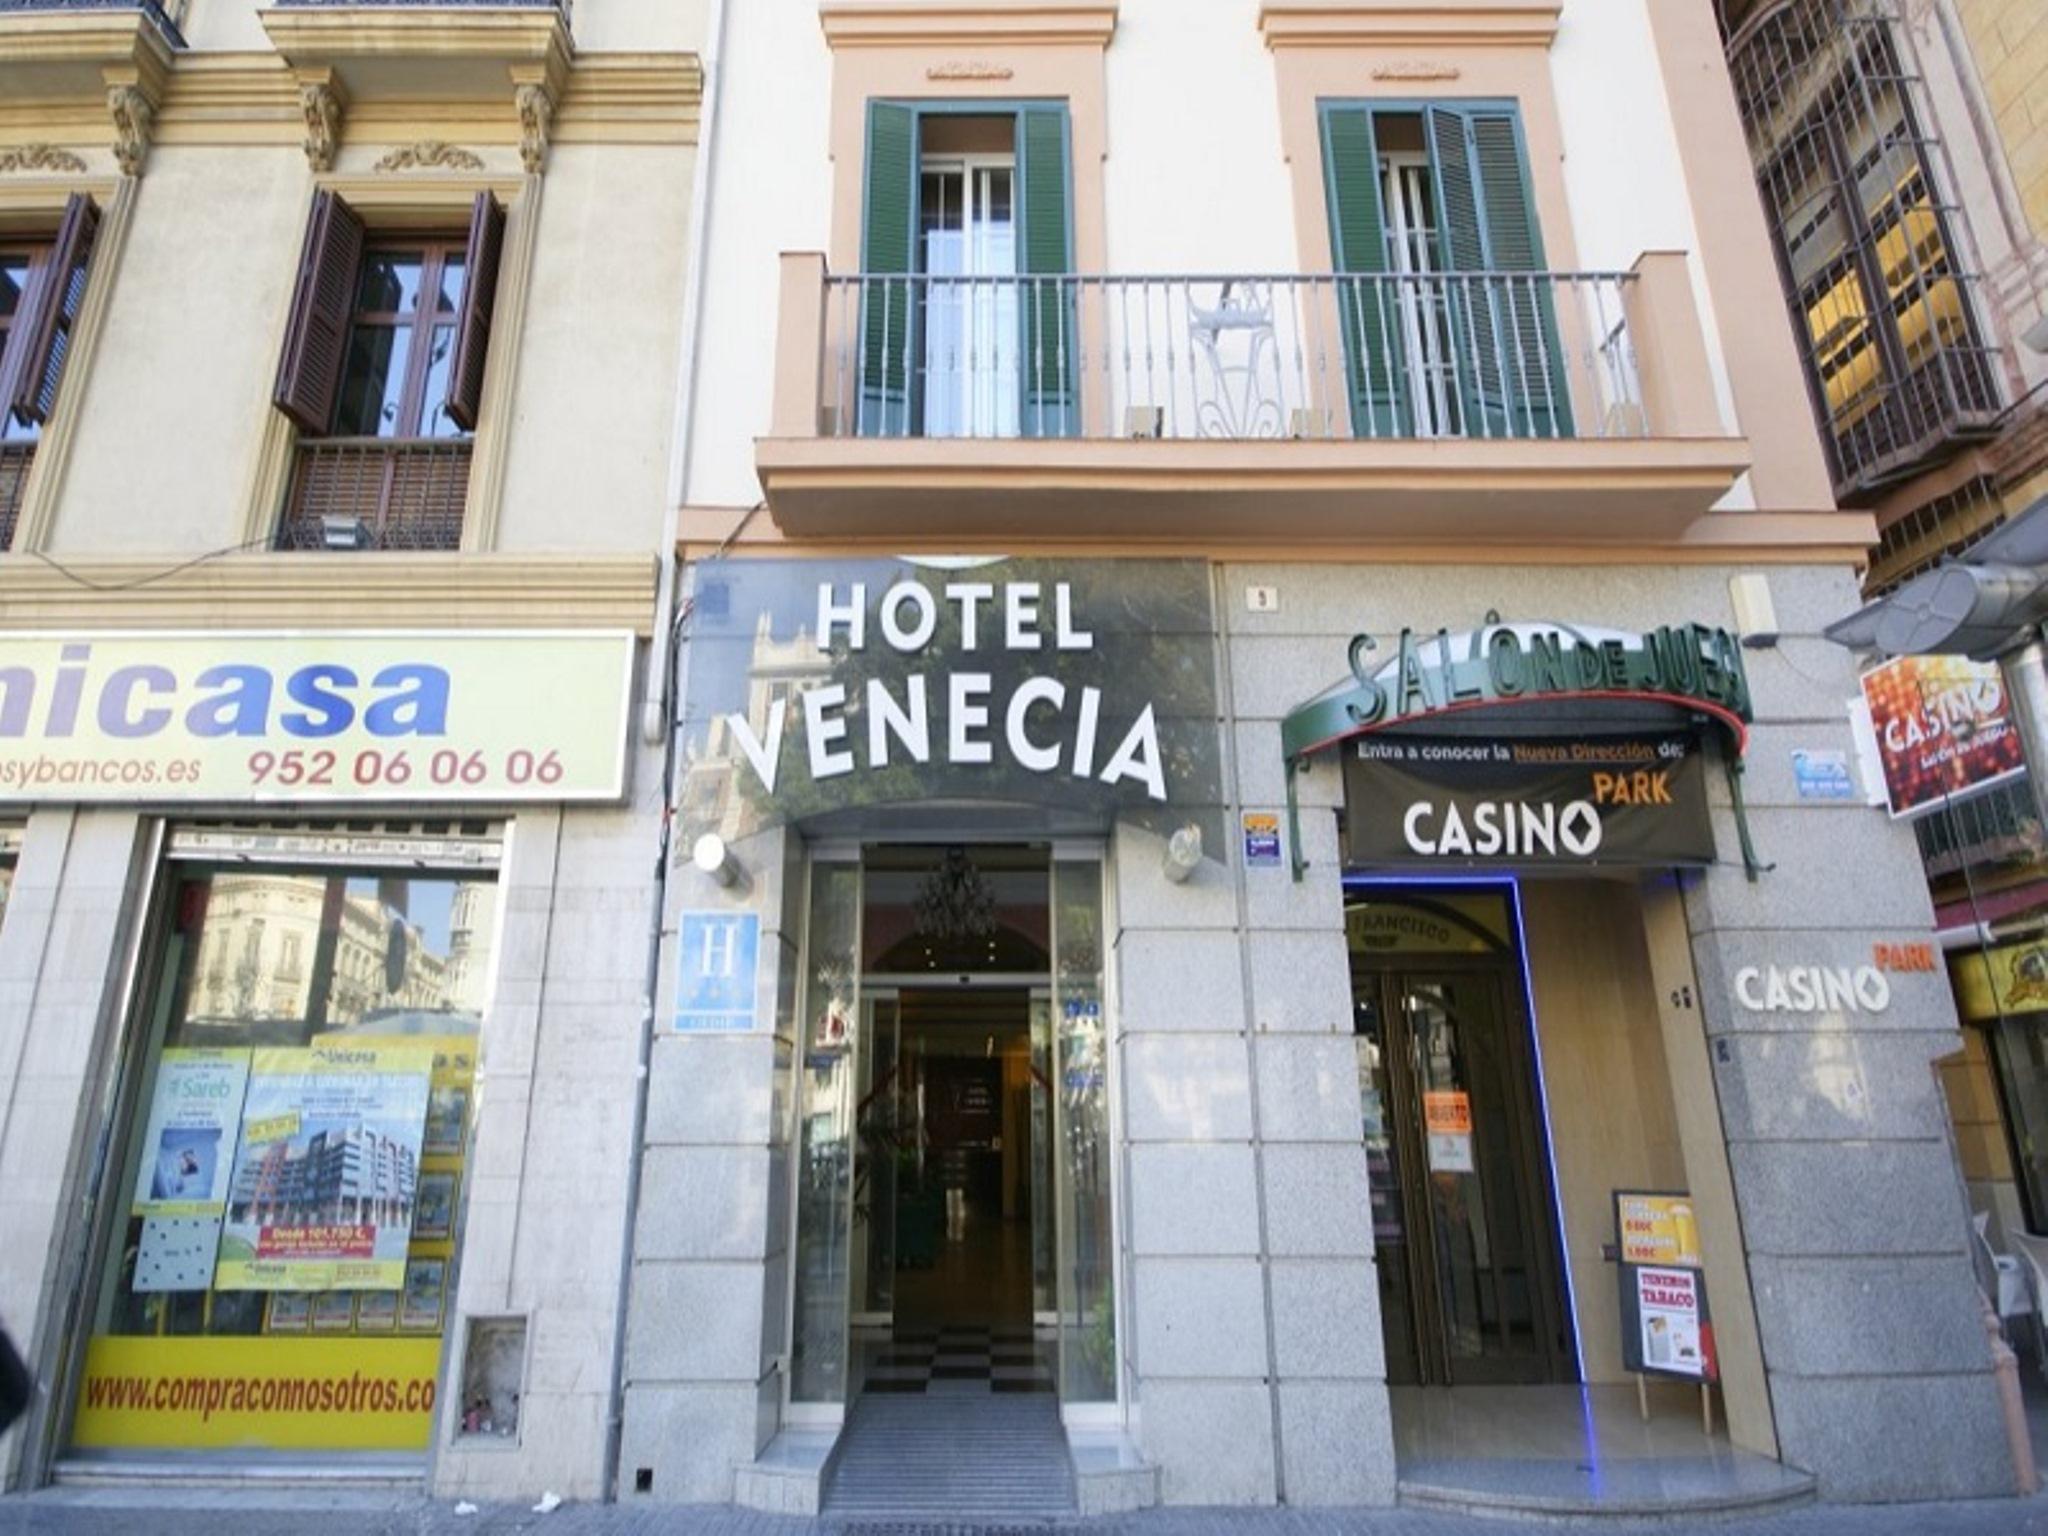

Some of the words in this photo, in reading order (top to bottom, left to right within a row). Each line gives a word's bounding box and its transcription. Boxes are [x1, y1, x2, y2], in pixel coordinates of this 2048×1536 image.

[817, 582, 1094, 651] HOTEL
[1572, 638, 1636, 690] DE
[726, 672, 1168, 801] VENECIA
[1885, 678, 2001, 753] CASINO
[247, 750, 336, 785] 952
[353, 750, 412, 785] 06
[429, 750, 488, 785] 06
[505, 750, 564, 785] 06
[1358, 742, 1403, 760] Entra
[1407, 747, 1418, 760] a
[1422, 746, 1490, 761] conocer
[1493, 745, 1511, 761] la
[1515, 744, 1570, 761] Nueva
[1572, 743, 1654, 761] Dirección
[1593, 771, 1672, 804] PARK
[1404, 800, 1602, 855] CASINO
[700, 923, 739, 977] H
[1872, 941, 1937, 974] PARK
[1735, 963, 1891, 1013] CASINO
[1642, 1289, 1695, 1308] TABACO
